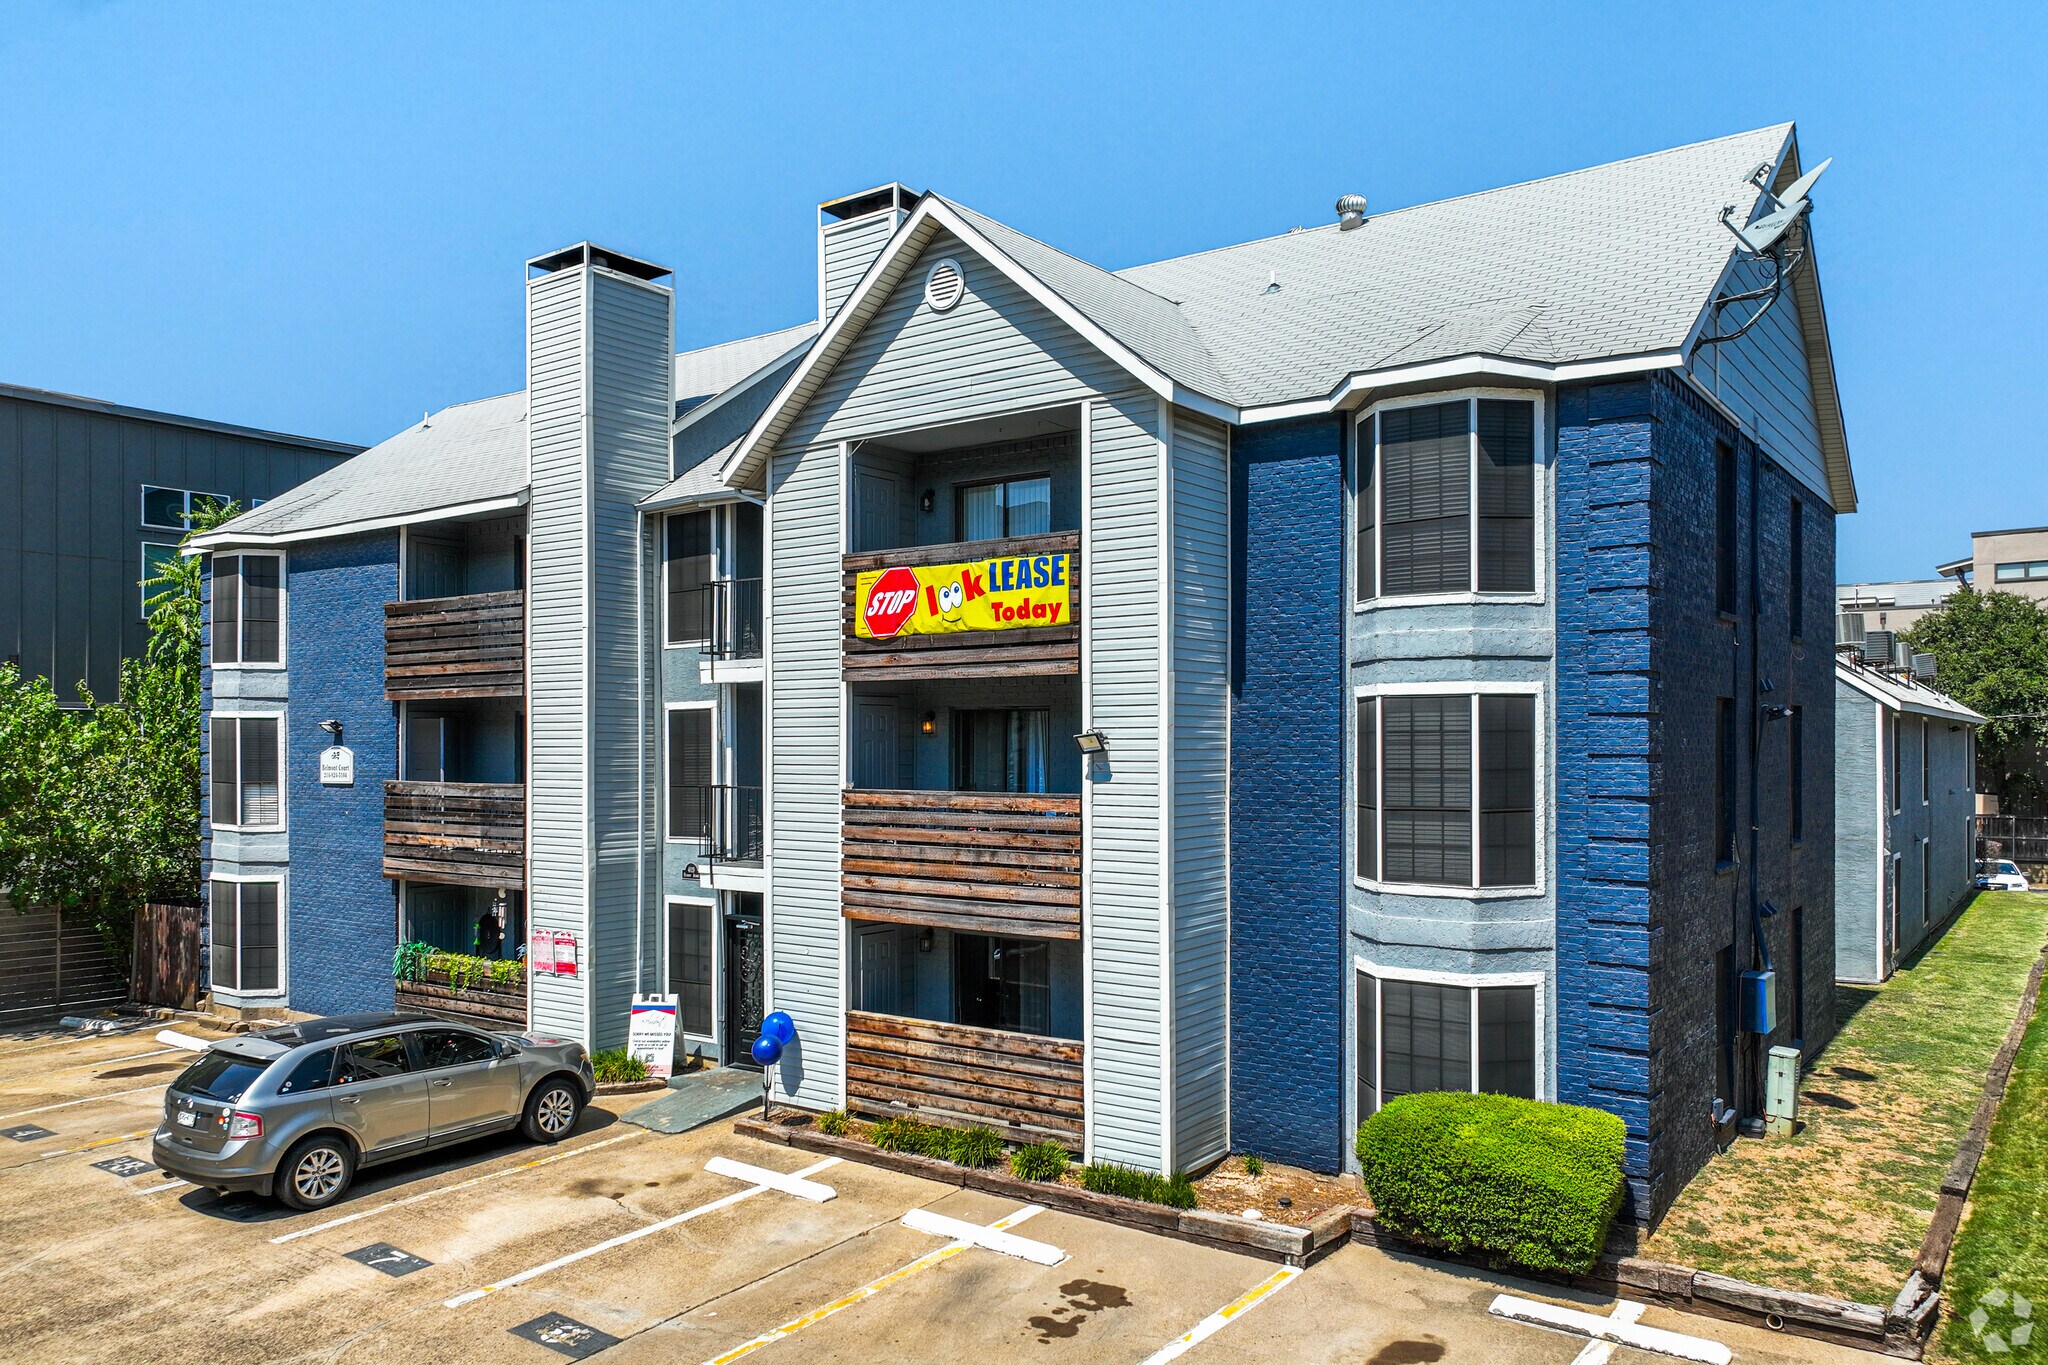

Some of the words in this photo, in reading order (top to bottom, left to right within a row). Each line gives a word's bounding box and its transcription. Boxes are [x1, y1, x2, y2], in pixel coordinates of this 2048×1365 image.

[988, 555, 1065, 593] LEASE
[867, 589, 916, 617] STOP
[991, 598, 1062, 623] Today
